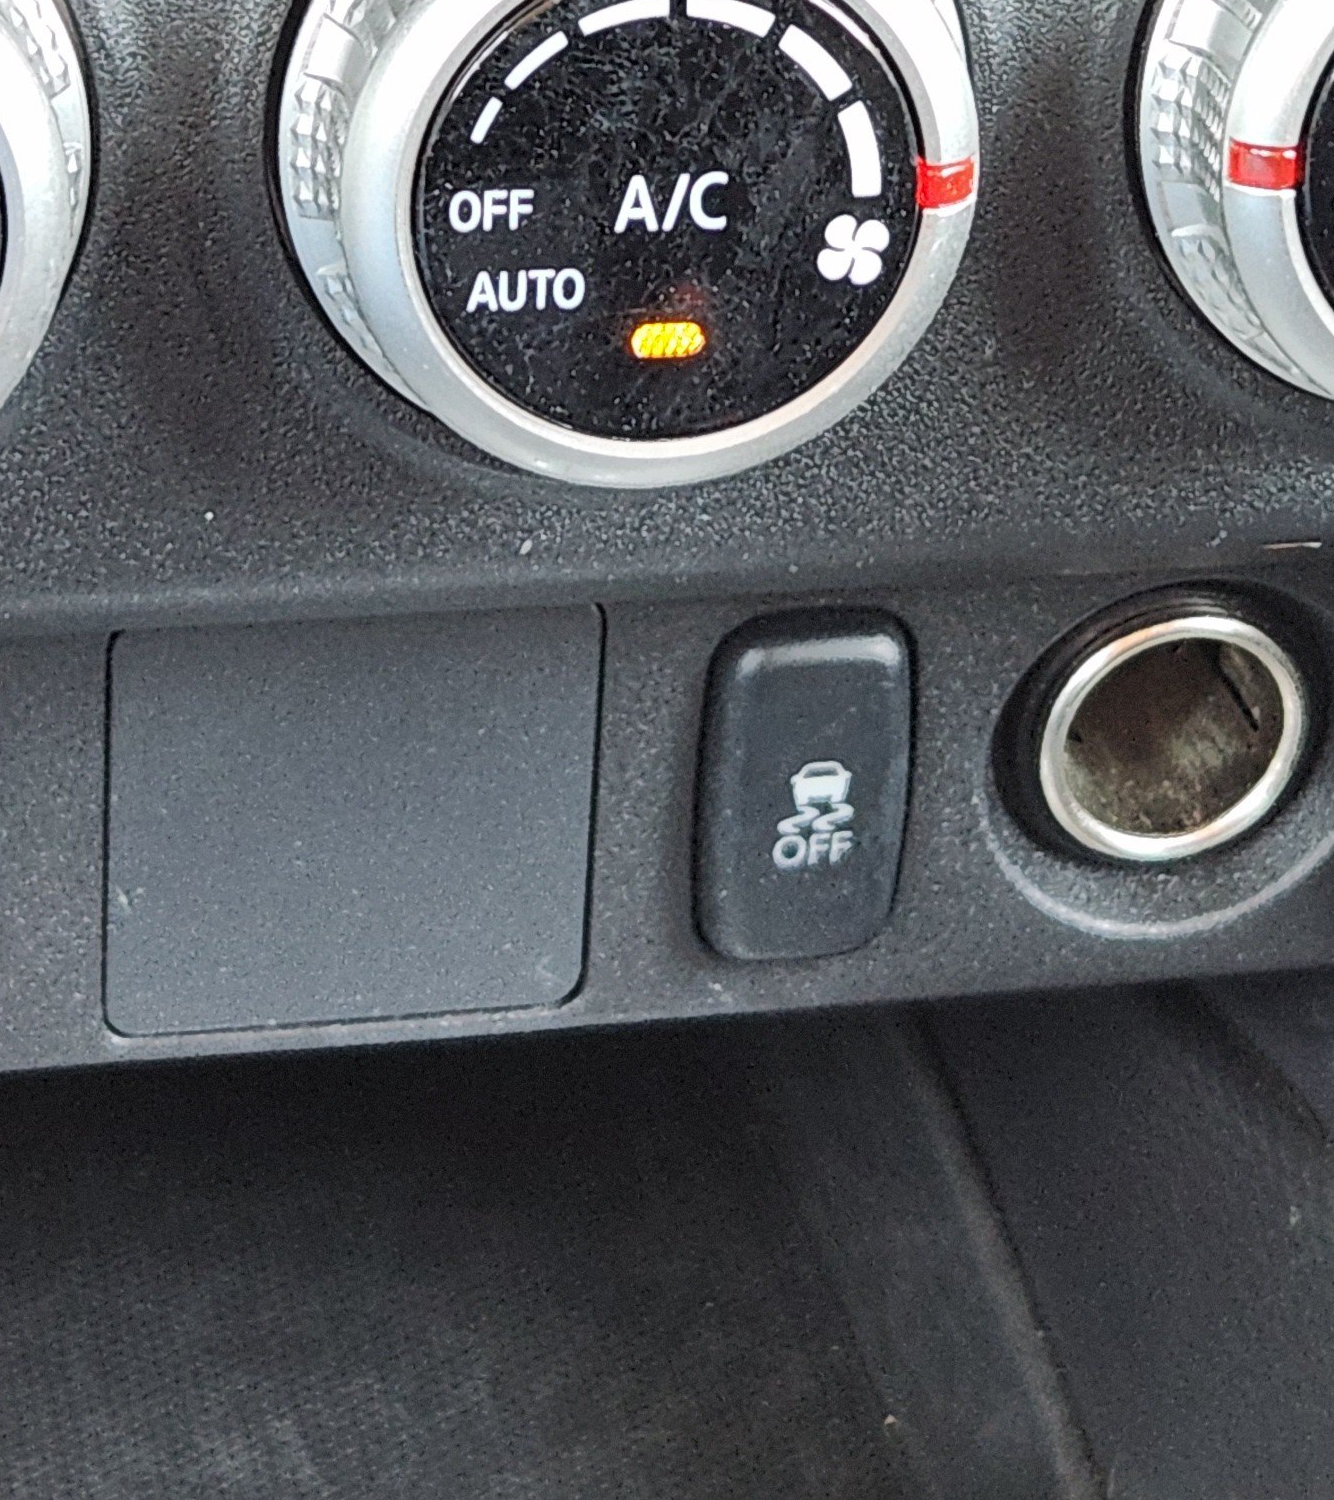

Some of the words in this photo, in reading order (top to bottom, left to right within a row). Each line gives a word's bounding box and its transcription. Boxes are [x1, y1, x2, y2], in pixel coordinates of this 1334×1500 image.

[448, 189, 535, 233] OFF
[614, 171, 730, 233] A/C
[466, 267, 585, 313] AUTO
[772, 830, 854, 870] OFF
